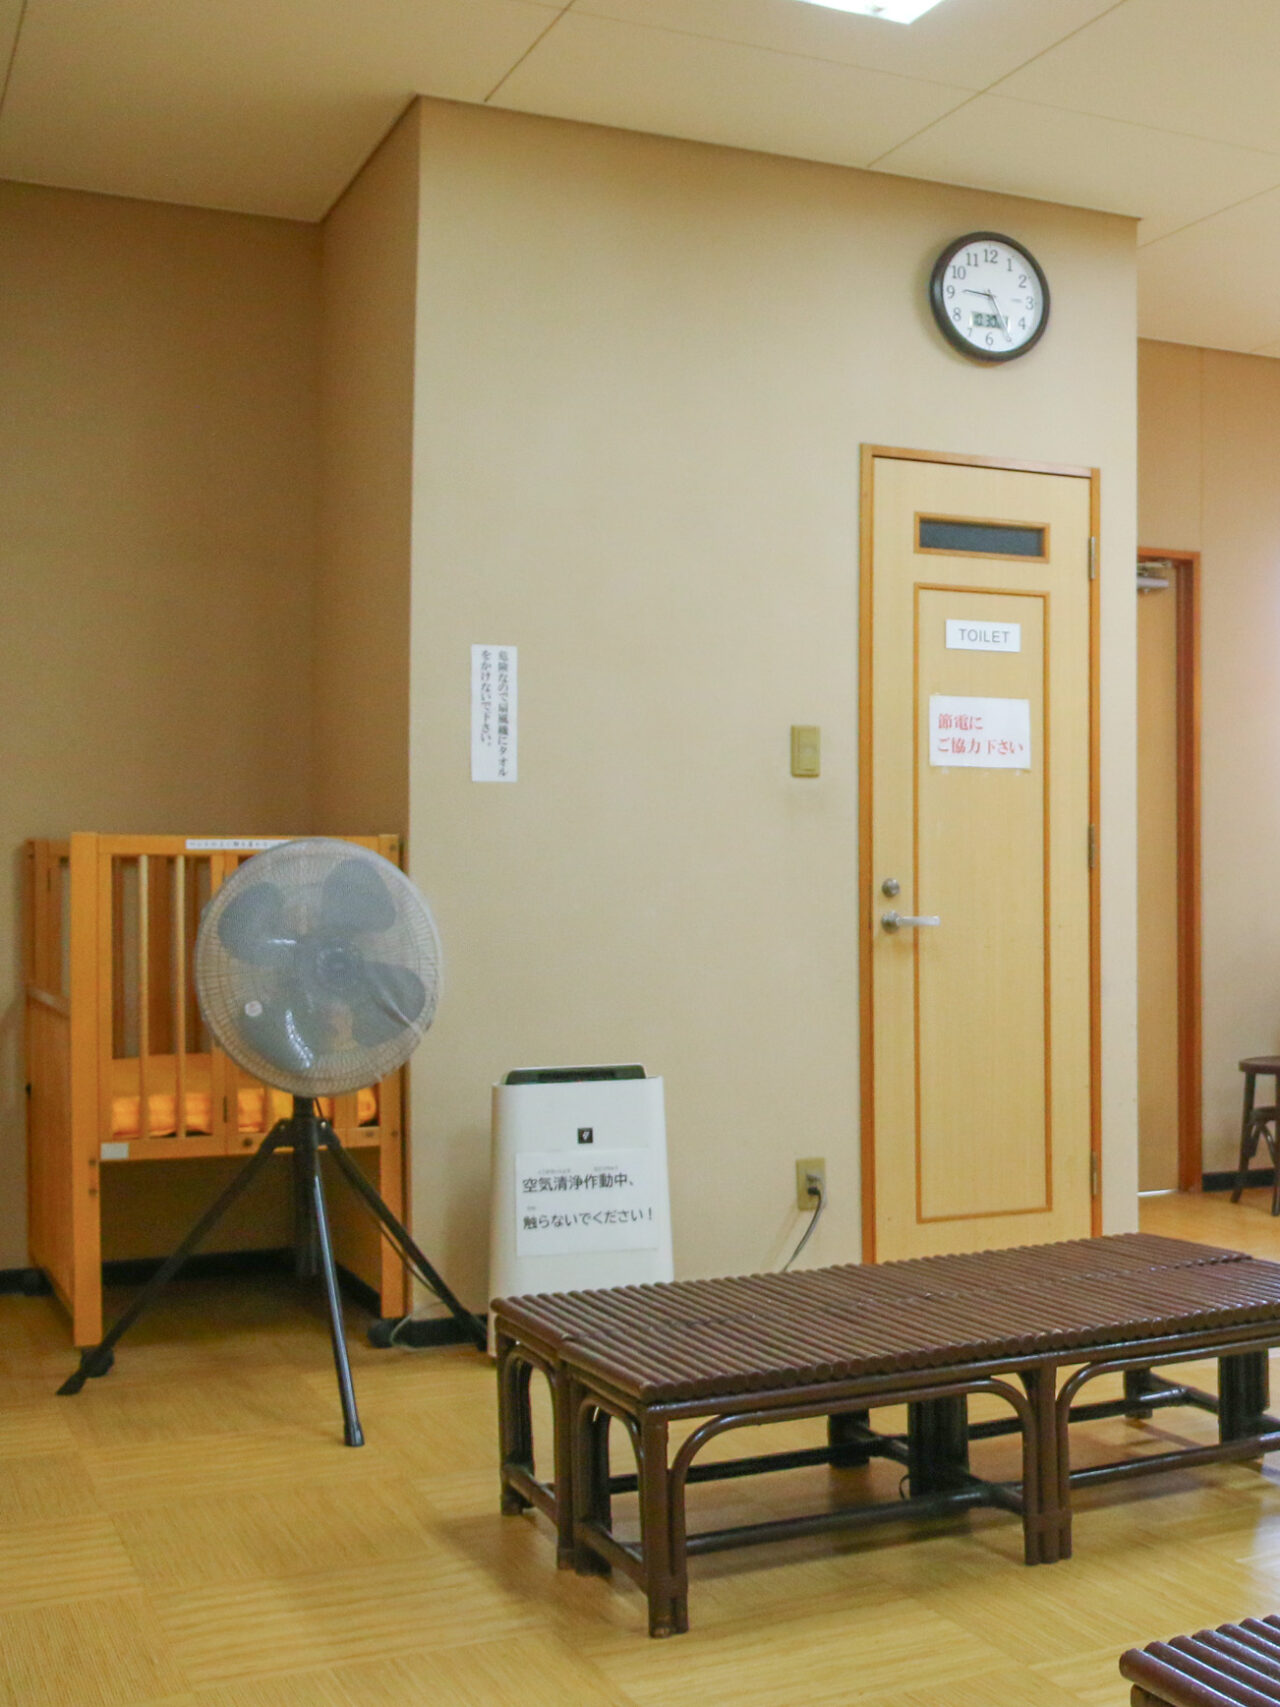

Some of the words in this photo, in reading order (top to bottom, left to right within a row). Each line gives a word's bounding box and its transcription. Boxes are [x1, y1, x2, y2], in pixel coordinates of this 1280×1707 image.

[966, 252, 978, 267] 11
[984, 248, 998, 263] 12
[951, 265, 966, 280] 10
[1007, 258, 1013, 272] 1
[1018, 274, 1027, 288] 2
[946, 285, 955, 299] 9
[1025, 296, 1034, 310] 3
[952, 307, 962, 321] 8
[1018, 316, 1026, 330] 4
[985, 331, 994, 346] 6
[958, 628, 1011, 644] TOILET
[938, 713, 984, 731] 節電に
[522, 1172, 634, 1193] 空気清浄作動中、
[523, 1207, 653, 1231] 触らないでください！
